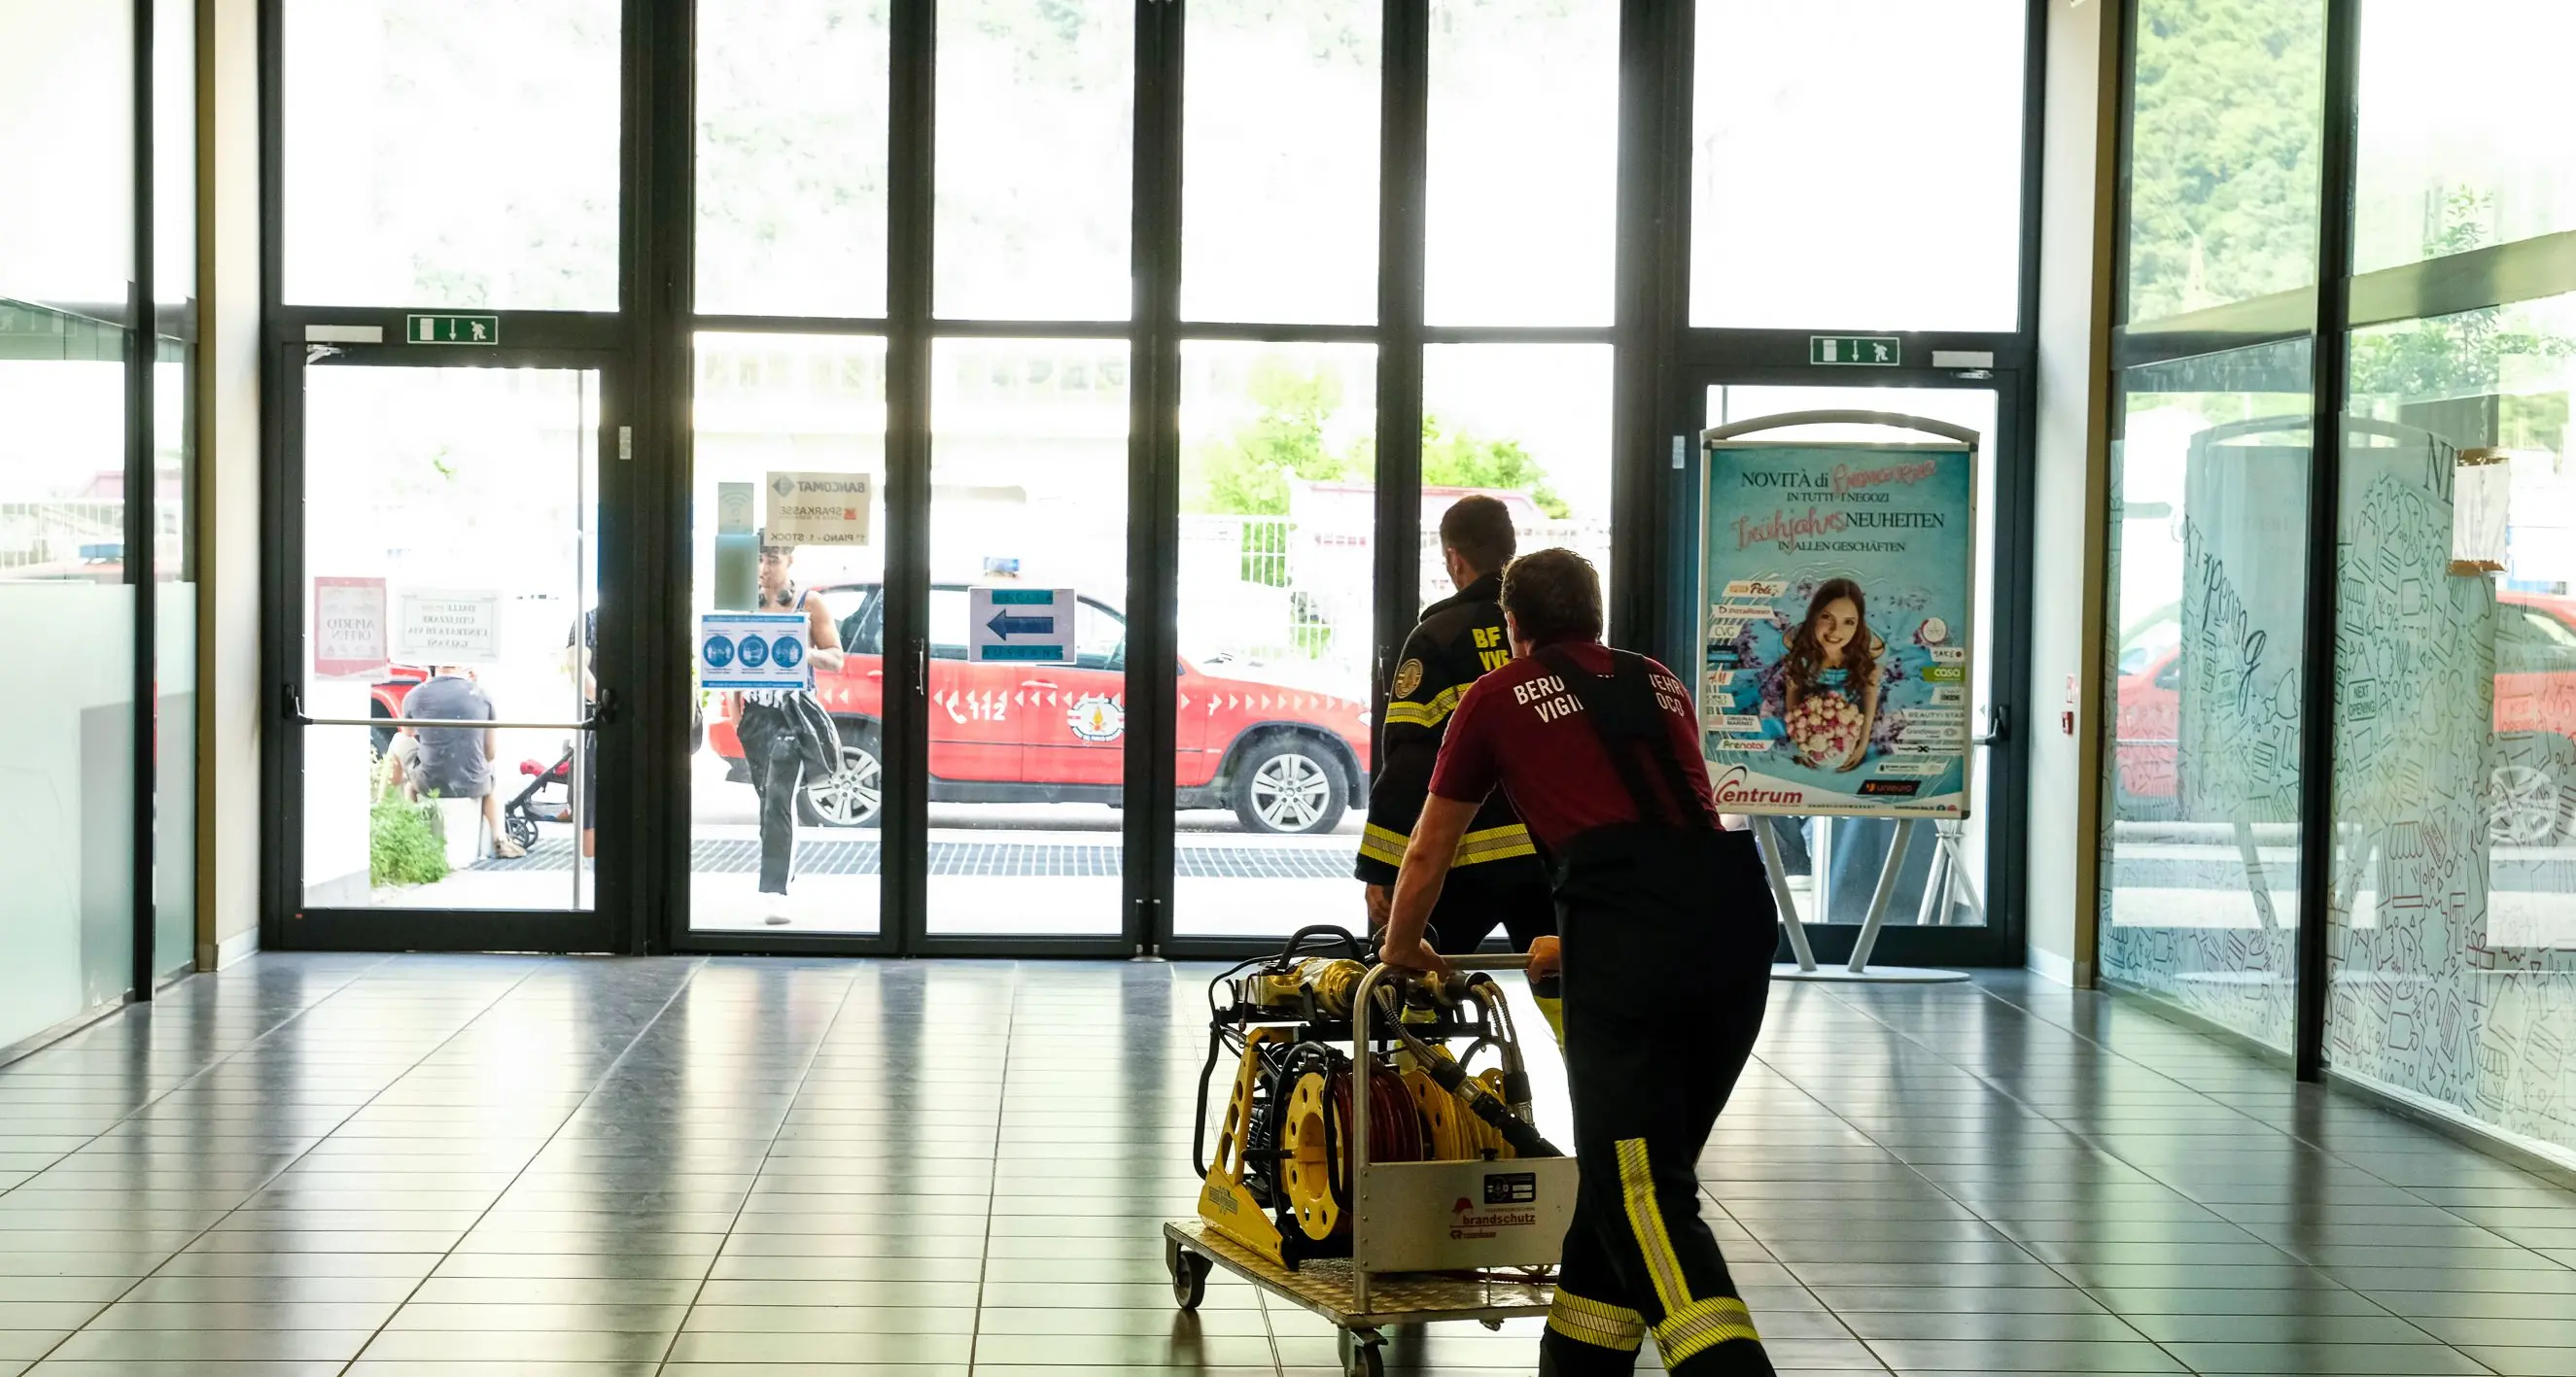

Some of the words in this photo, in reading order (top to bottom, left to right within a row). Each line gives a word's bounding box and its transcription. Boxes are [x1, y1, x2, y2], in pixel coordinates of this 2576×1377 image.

[1741, 467, 1812, 488] NOVITÀ
[1815, 472, 1828, 488] di
[1787, 493, 1798, 502] IN
[1800, 493, 1833, 502] TUTTI
[1847, 493, 1890, 503] NEGOZI
[1846, 512, 1945, 529] NEUHEITEN
[1778, 541, 1790, 551] IN
[1795, 541, 1830, 552] ALLEN
[1832, 540, 1906, 552] GESCHÄFTEN
[1472, 626, 1502, 648] BF
[1933, 668, 1961, 677] casa
[2353, 685, 2370, 700] NEXT
[970, 702, 1006, 721] 112
[2348, 701, 2377, 716] OPENING
[1715, 778, 1803, 804] Centrum
[1462, 1213, 1536, 1226] brandschutz
